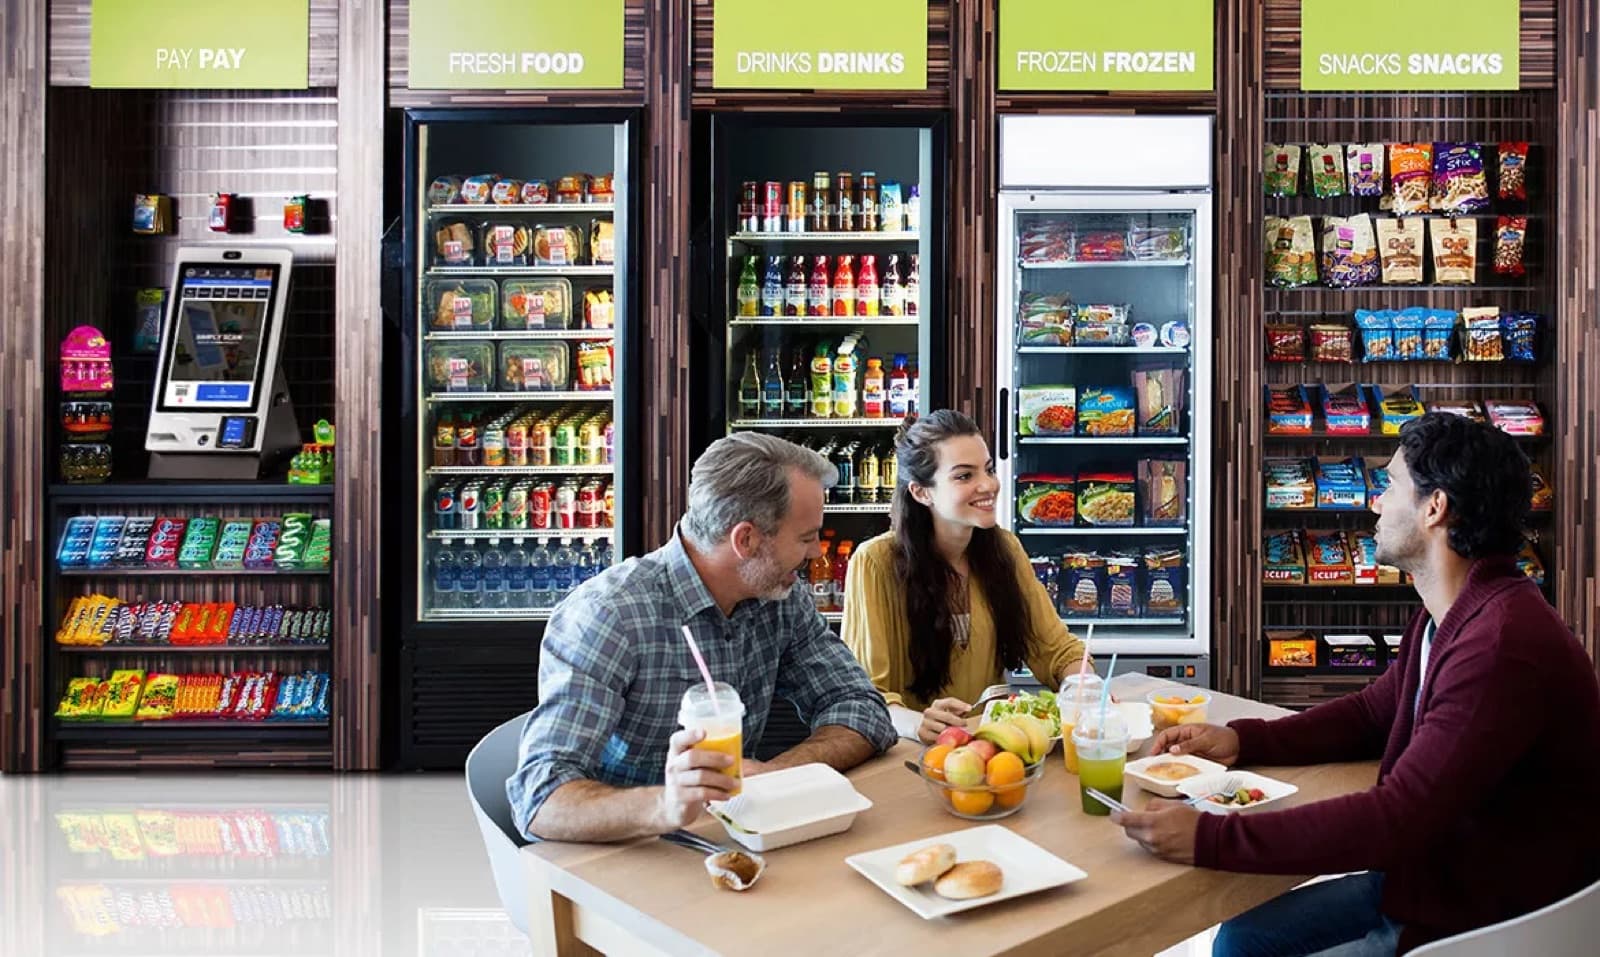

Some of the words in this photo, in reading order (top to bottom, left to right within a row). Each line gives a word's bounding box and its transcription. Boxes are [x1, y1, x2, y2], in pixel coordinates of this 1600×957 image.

[156, 48, 193, 70] PAY
[198, 48, 246, 70] PAY
[449, 51, 516, 75] FRESH
[520, 51, 585, 75] FOOD
[736, 51, 814, 74] DRINKS
[817, 51, 906, 74] DRINKS
[1016, 50, 1098, 74] FROZEN
[1102, 50, 1197, 74] FROZEN
[1318, 52, 1401, 75] SNACKS
[1407, 52, 1503, 75] SNACKS
[1400, 159, 1425, 170] Stix
[1446, 157, 1472, 170] Stix
[1268, 570, 1291, 579] CLIF
[1317, 571, 1340, 580] CLIF
